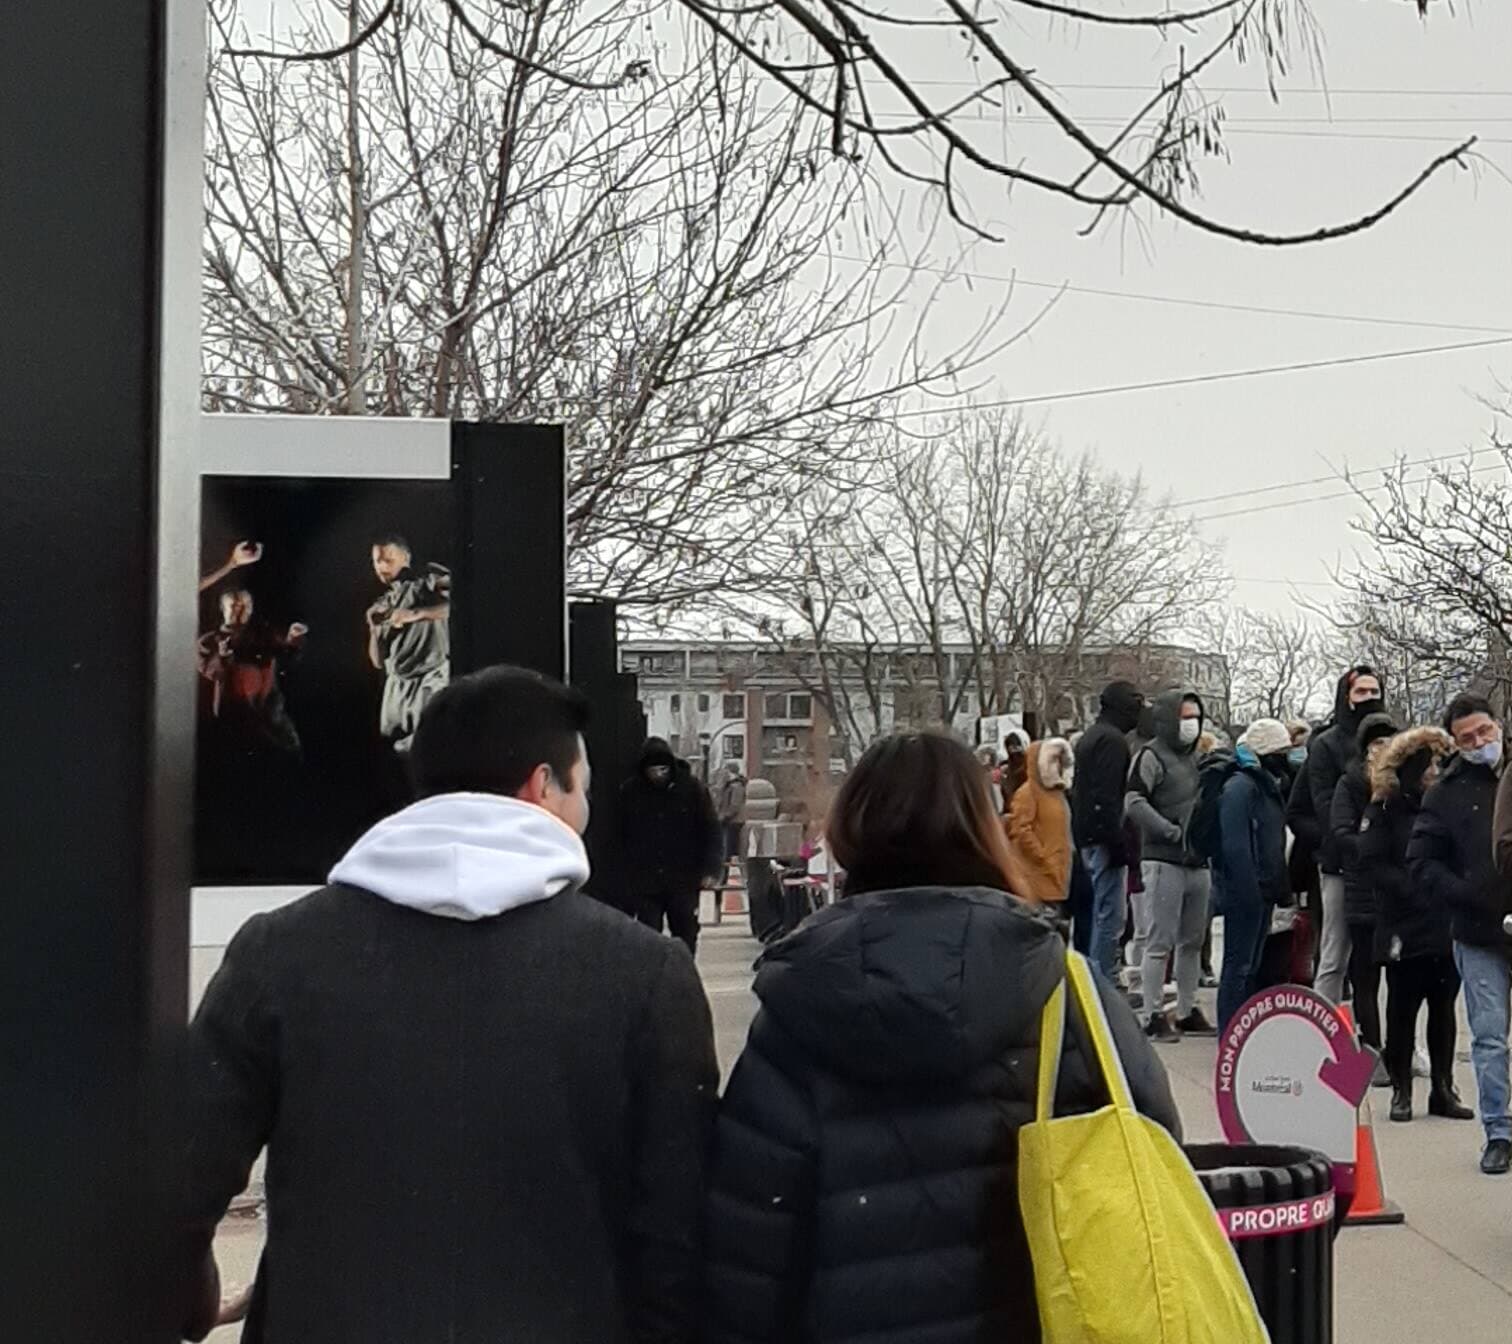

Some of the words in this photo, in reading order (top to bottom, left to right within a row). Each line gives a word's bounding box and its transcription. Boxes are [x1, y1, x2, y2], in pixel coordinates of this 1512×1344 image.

[1220, 1048, 1235, 1092] MON
[1229, 997, 1273, 1047] PROPRE
[1275, 994, 1339, 1037] QUARTIER
[1231, 1203, 1309, 1232] PROPRE
